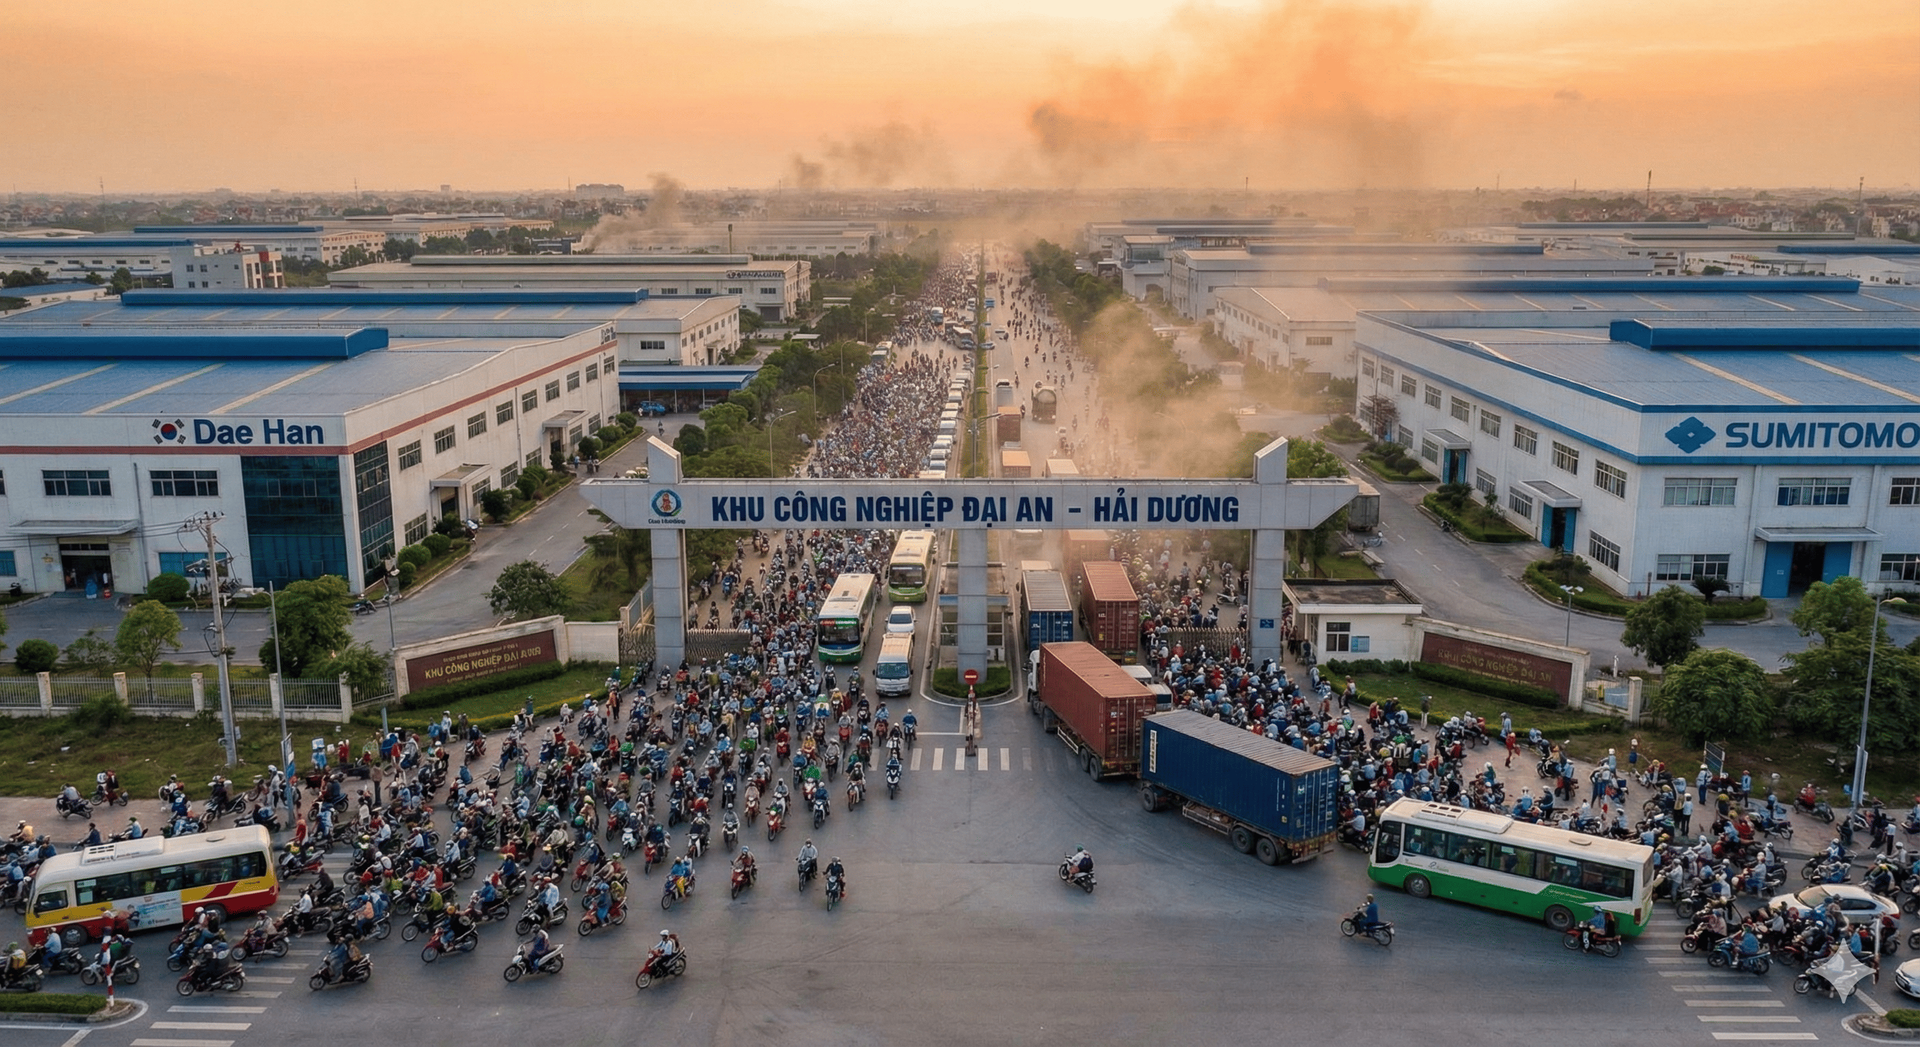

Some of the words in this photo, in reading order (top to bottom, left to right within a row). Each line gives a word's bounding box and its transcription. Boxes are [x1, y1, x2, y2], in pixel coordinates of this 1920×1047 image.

[193, 418, 253, 445] Dae
[262, 418, 324, 445] Han
[1725, 421, 1920, 449] SUMITOMO
[711, 496, 764, 522] KHU
[774, 490, 847, 522] CÔNG
[856, 490, 954, 528] NGHIỆP
[962, 496, 1007, 528] ĐẠI
[1015, 496, 1053, 522] AN
[1094, 487, 1138, 523] HẢI
[1147, 494, 1239, 523] DƯƠNG
[425, 666, 444, 680] KHU
